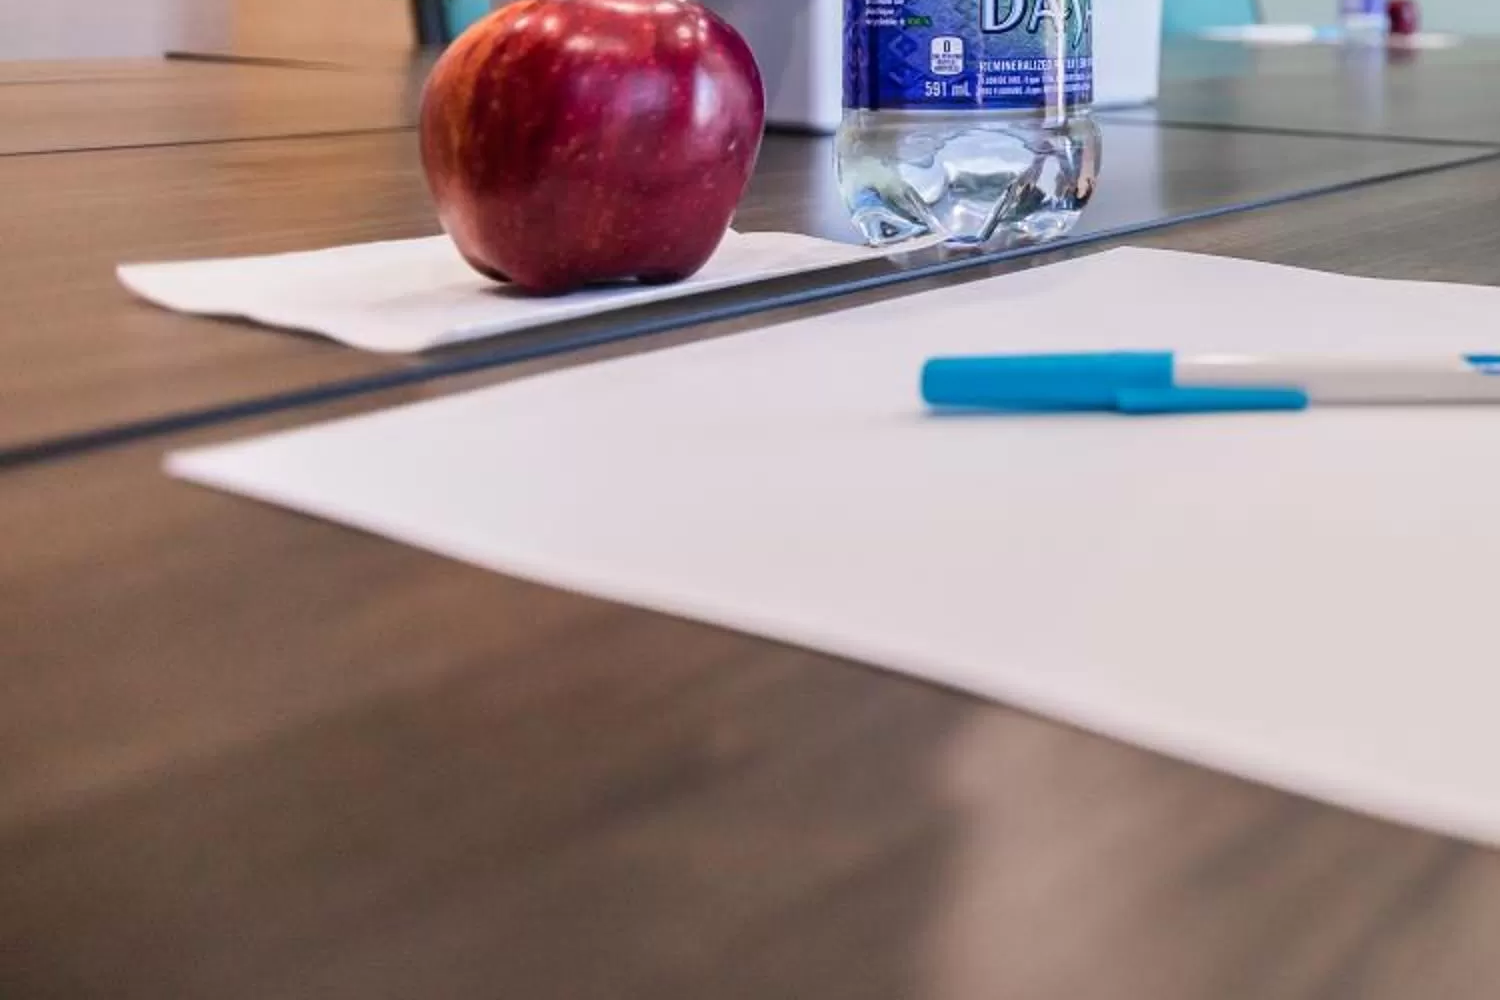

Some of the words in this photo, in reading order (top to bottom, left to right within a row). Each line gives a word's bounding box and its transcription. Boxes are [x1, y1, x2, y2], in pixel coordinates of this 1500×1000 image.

[943, 39, 951, 53] 0
[925, 81, 947, 97] 591
[951, 81, 972, 97] mL
